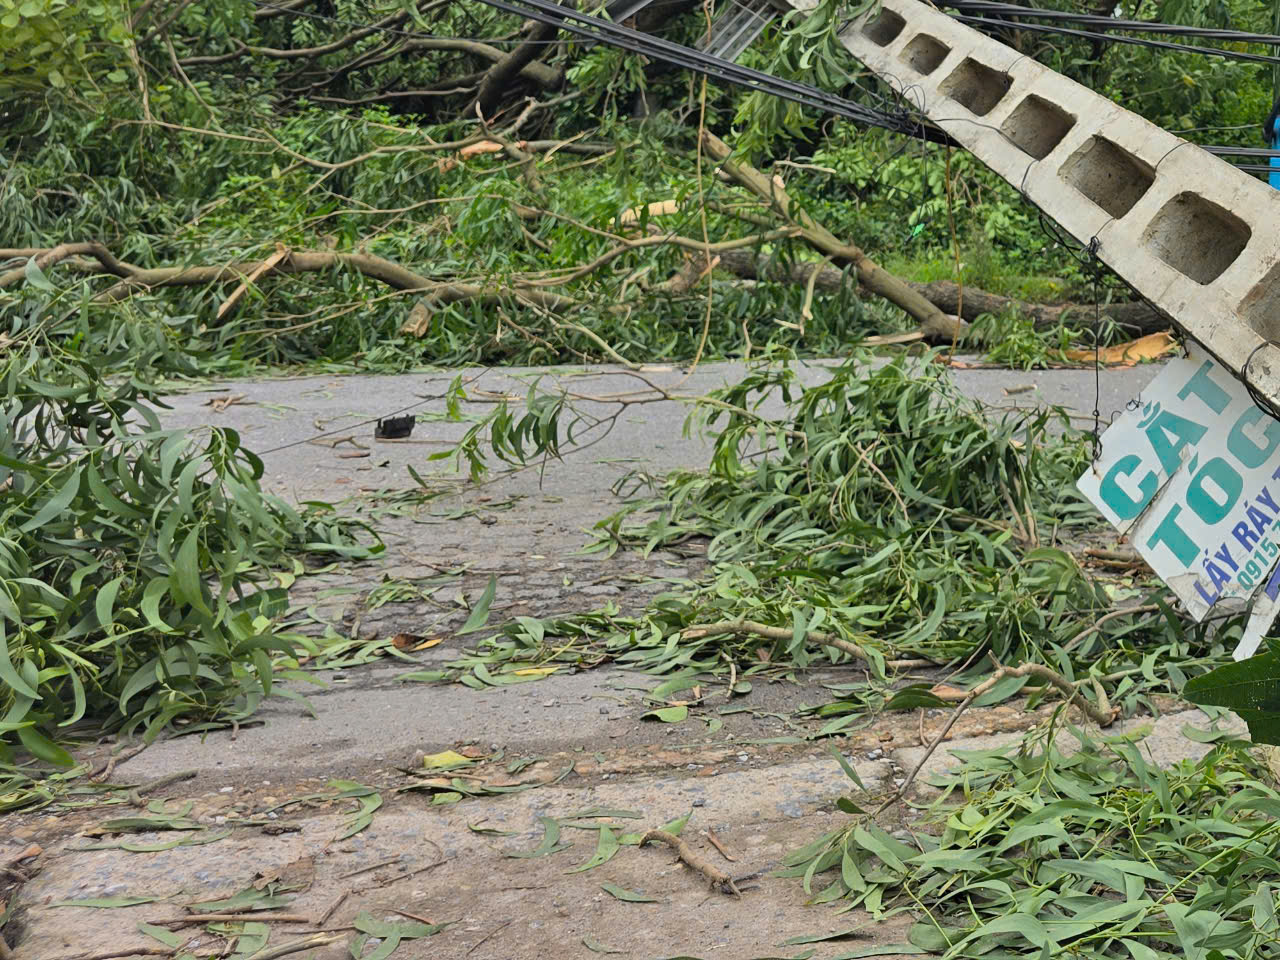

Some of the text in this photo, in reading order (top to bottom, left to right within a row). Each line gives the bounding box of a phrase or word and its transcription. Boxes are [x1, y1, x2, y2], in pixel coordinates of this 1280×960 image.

[1099, 359, 1233, 521] CẮT
[1193, 541, 1240, 607] LẤY
[1231, 485, 1280, 553] RÁY
[1237, 537, 1278, 591] 0915
